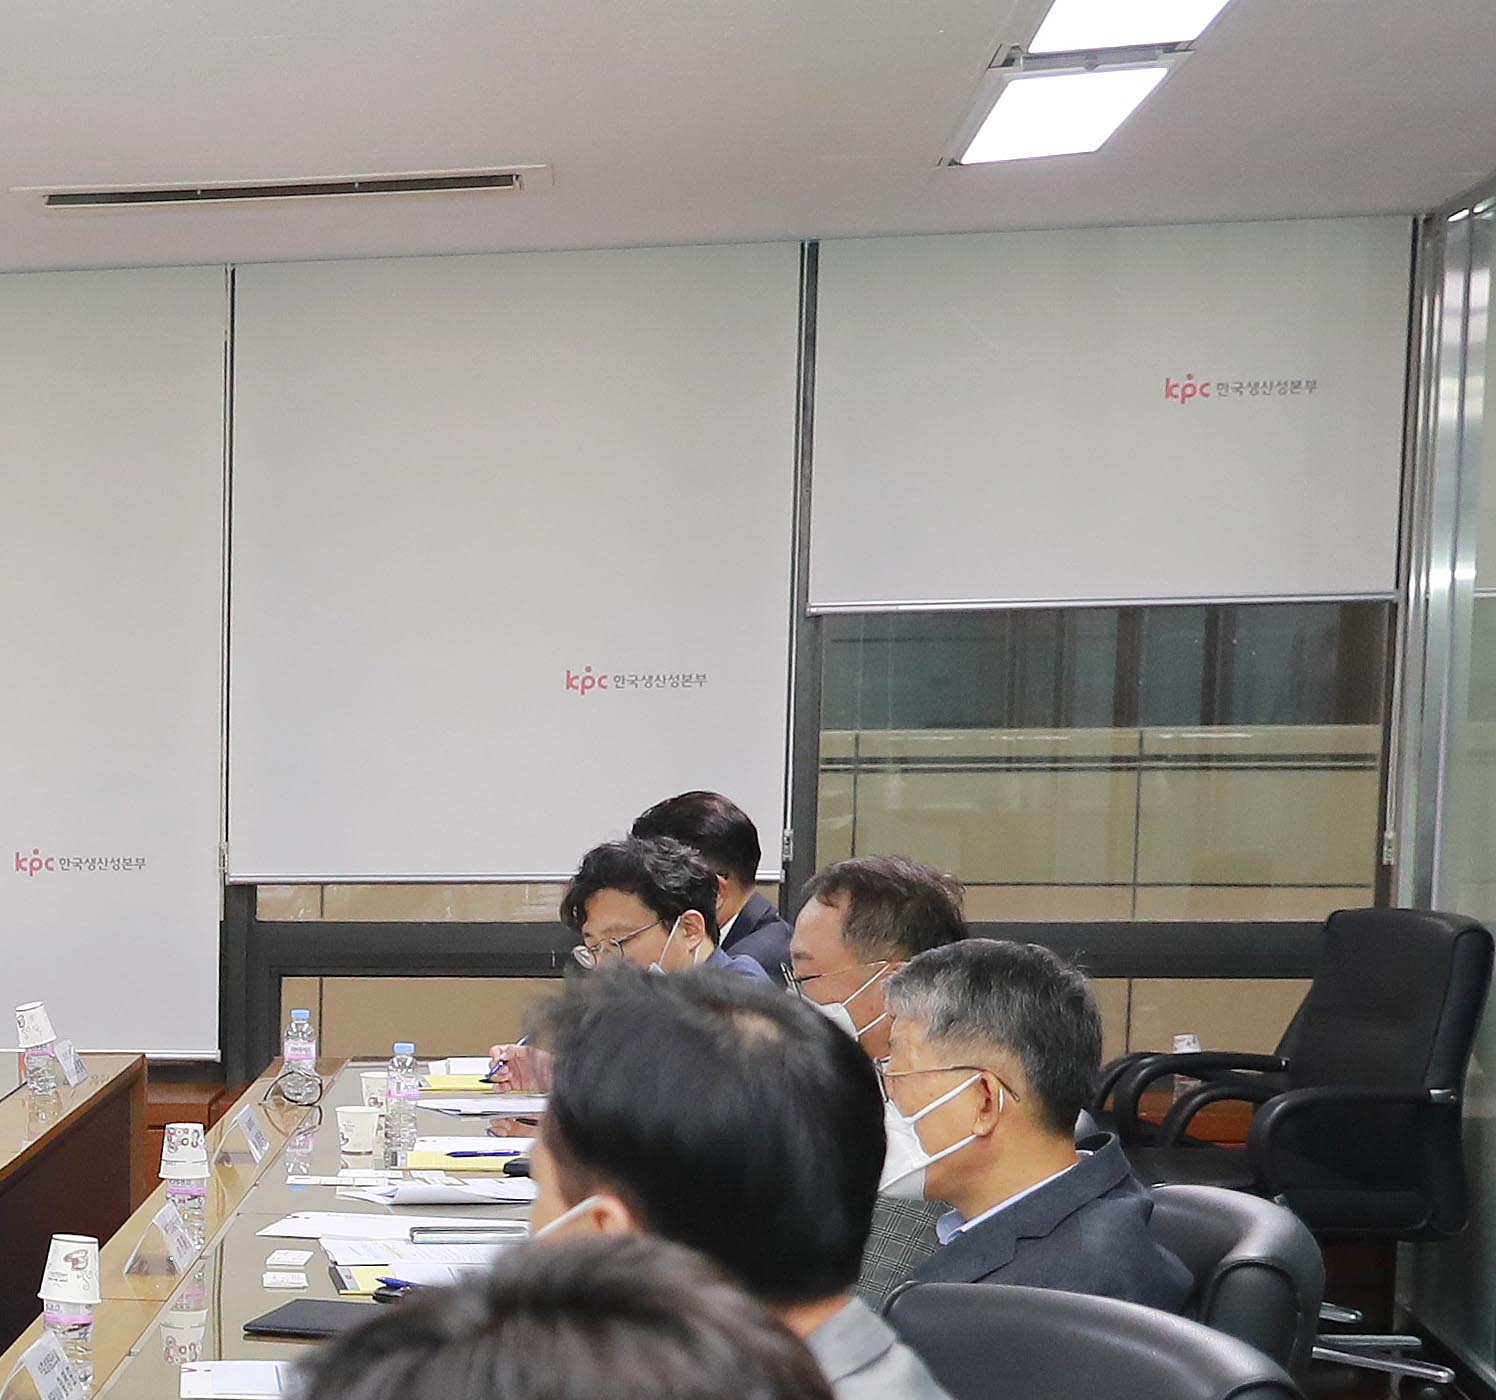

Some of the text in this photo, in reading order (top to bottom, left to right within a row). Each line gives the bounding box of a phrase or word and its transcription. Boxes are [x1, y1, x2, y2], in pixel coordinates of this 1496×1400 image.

[1165, 373, 1318, 404] kpc 한국생산성본부
[565, 666, 709, 695] kpc 한국생산성본부
[15, 848, 146, 877] kpc 한국생산성본부
